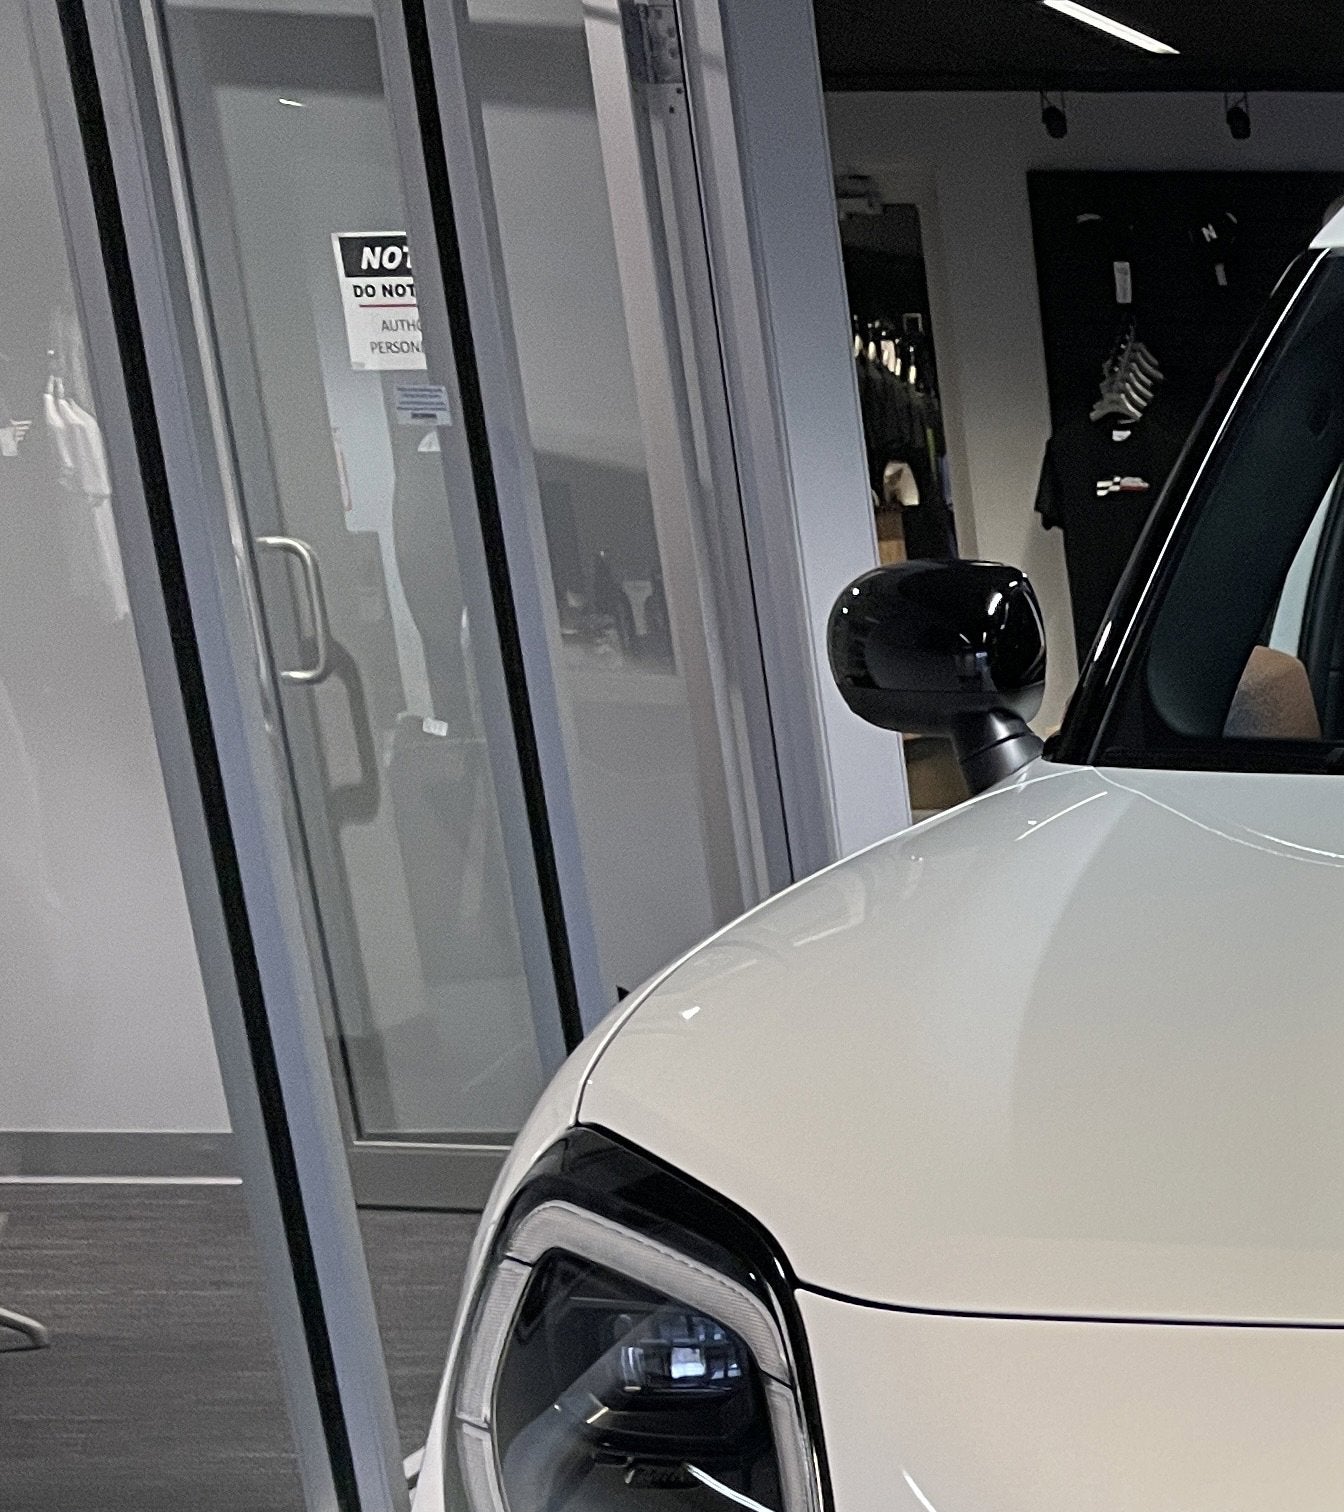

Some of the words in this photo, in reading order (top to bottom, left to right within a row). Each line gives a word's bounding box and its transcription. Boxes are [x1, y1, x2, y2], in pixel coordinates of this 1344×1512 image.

[352, 283, 376, 298] DO
[382, 283, 415, 298] NOT
[370, 341, 424, 354] PERSON
